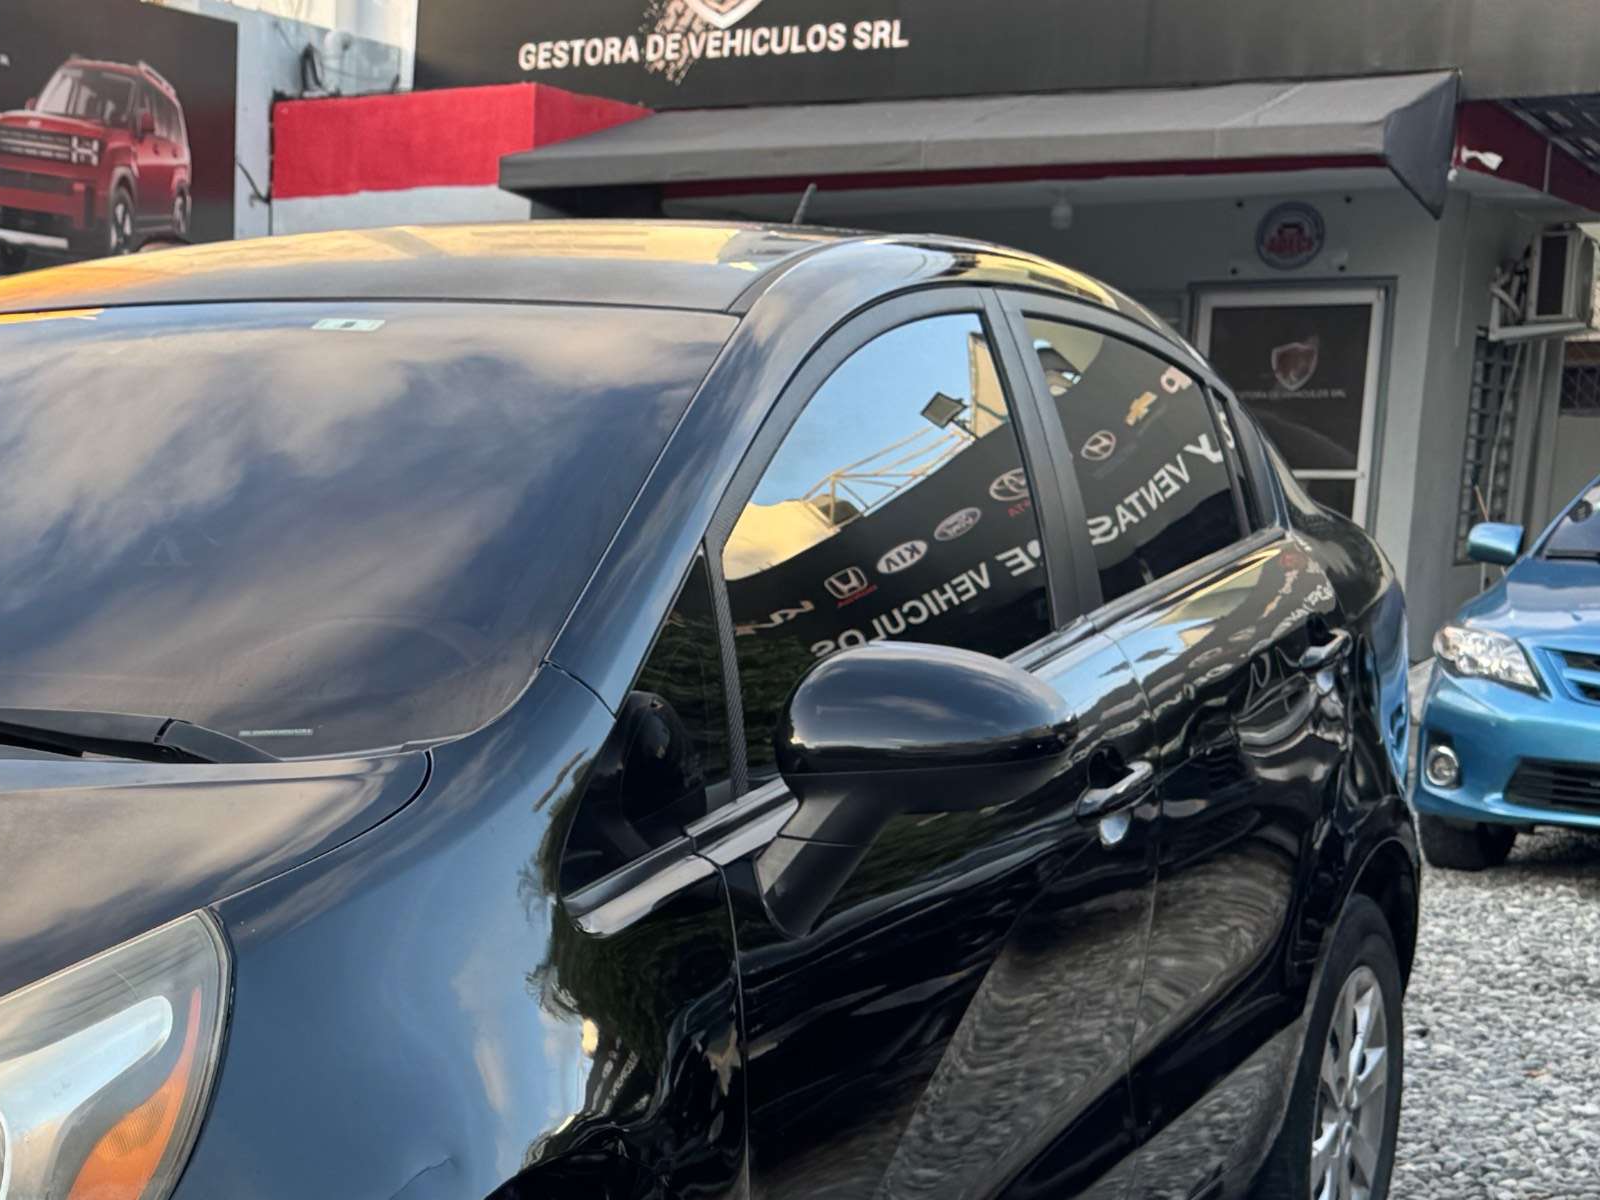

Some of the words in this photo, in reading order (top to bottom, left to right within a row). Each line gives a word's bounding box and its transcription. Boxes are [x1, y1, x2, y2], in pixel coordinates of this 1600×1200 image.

[518, 35, 640, 71] GESTORA
[646, 32, 682, 62] DE
[687, 22, 847, 59] VEHICULOS
[852, 19, 909, 50] SRL
